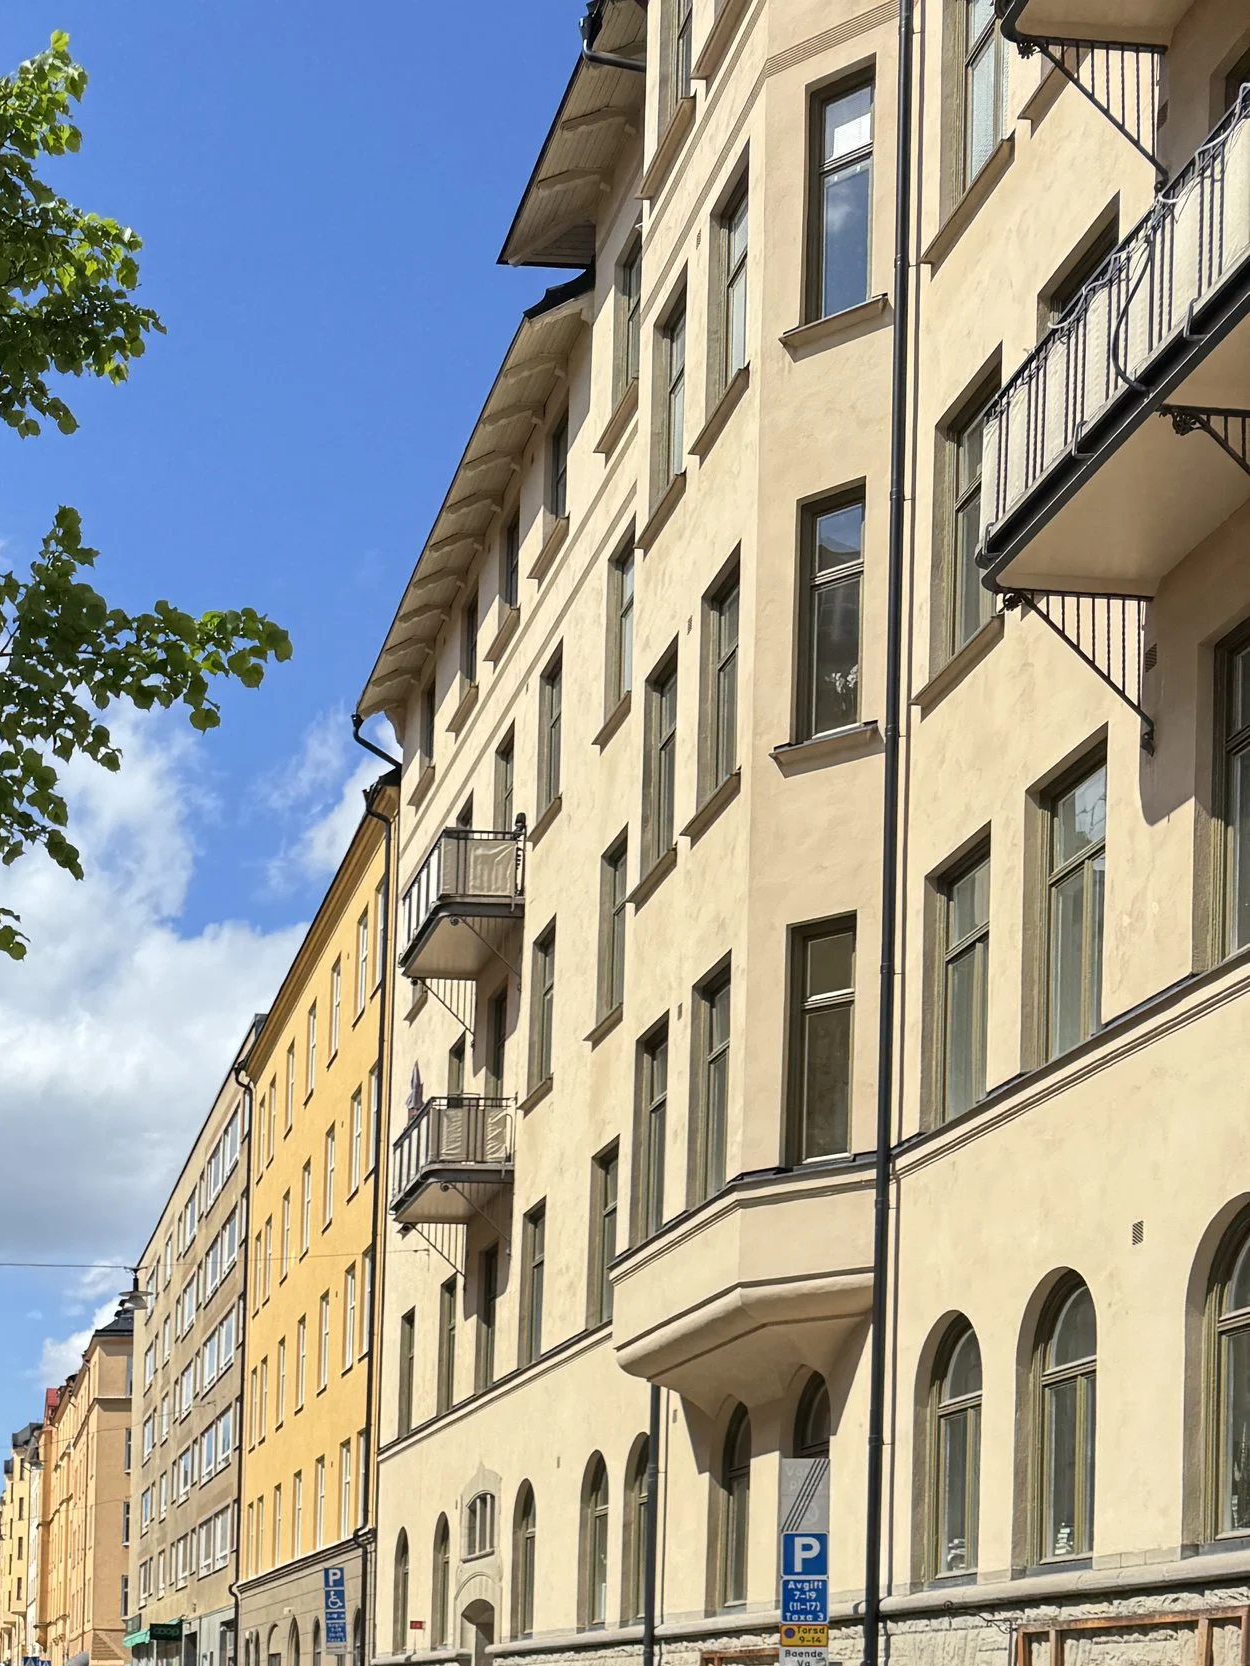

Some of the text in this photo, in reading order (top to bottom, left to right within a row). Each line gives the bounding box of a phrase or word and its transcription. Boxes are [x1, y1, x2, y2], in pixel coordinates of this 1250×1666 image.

[794, 1536, 821, 1573] P
[328, 1568, 341, 1587] P
[787, 1580, 823, 1591] Avgift
[793, 1591, 817, 1600] 7-19
[785, 1612, 825, 1621] Taxa 3
[796, 1626, 826, 1634] Torsd
[798, 1636, 823, 1644] 9-14
[784, 1649, 824, 1658] Boende
